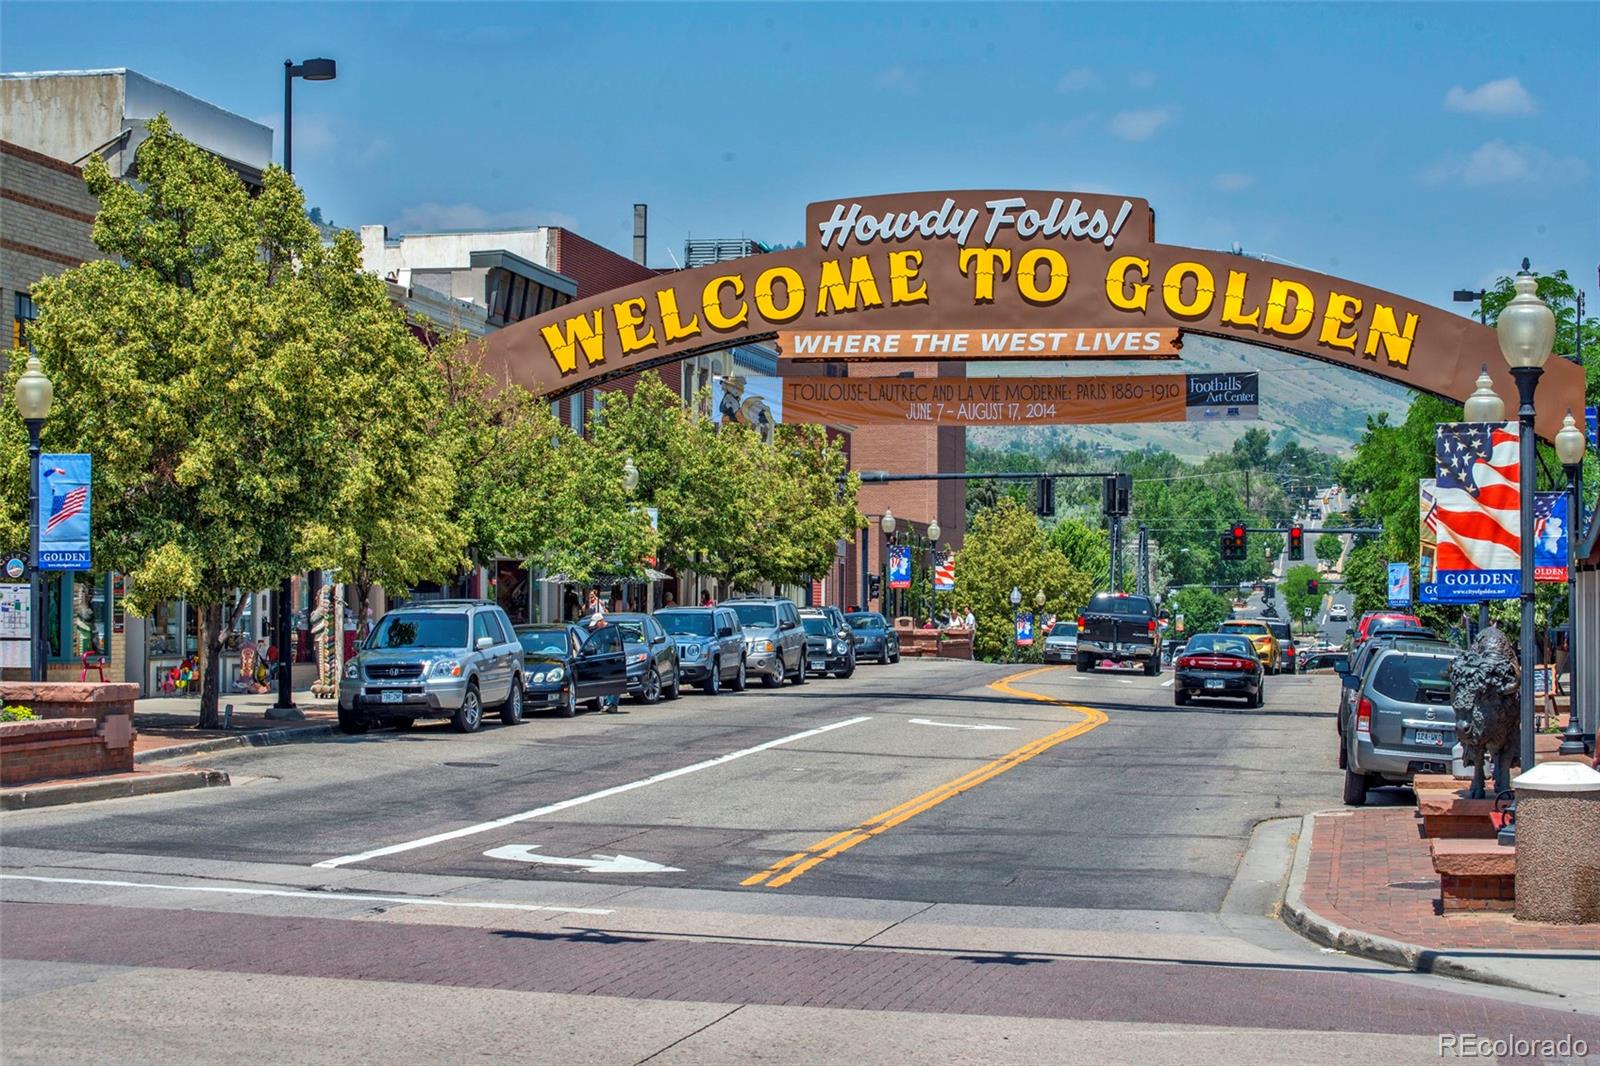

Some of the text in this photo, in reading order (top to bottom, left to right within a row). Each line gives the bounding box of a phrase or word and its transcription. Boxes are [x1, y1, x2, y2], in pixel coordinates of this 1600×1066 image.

[819, 198, 1133, 248] Howdy Folks!
[540, 247, 1420, 375] WELCOME TO GOLDEN
[794, 332, 1161, 354] WHERE THE WEST LIVES
[933, 384, 954, 401] AND
[958, 384, 974, 401] LA
[979, 384, 1001, 401] VIE
[1006, 384, 1072, 401] MODERNE:
[1076, 383, 1106, 400] PARIS
[1112, 383, 1180, 401] 1880-1910
[1190, 376, 1242, 393] Foothills
[1206, 391, 1256, 402] Art Center
[906, 402, 933, 420] JUNE
[936, 403, 945, 421] 7
[956, 402, 1004, 420] AUGUST
[1008, 402, 1021, 421] 17,
[1025, 403, 1057, 419] 2014
[43, 552, 86, 561] GOLDEN
[1444, 573, 1513, 585] GOLDEN
[1534, 568, 1564, 576] OLDEN
